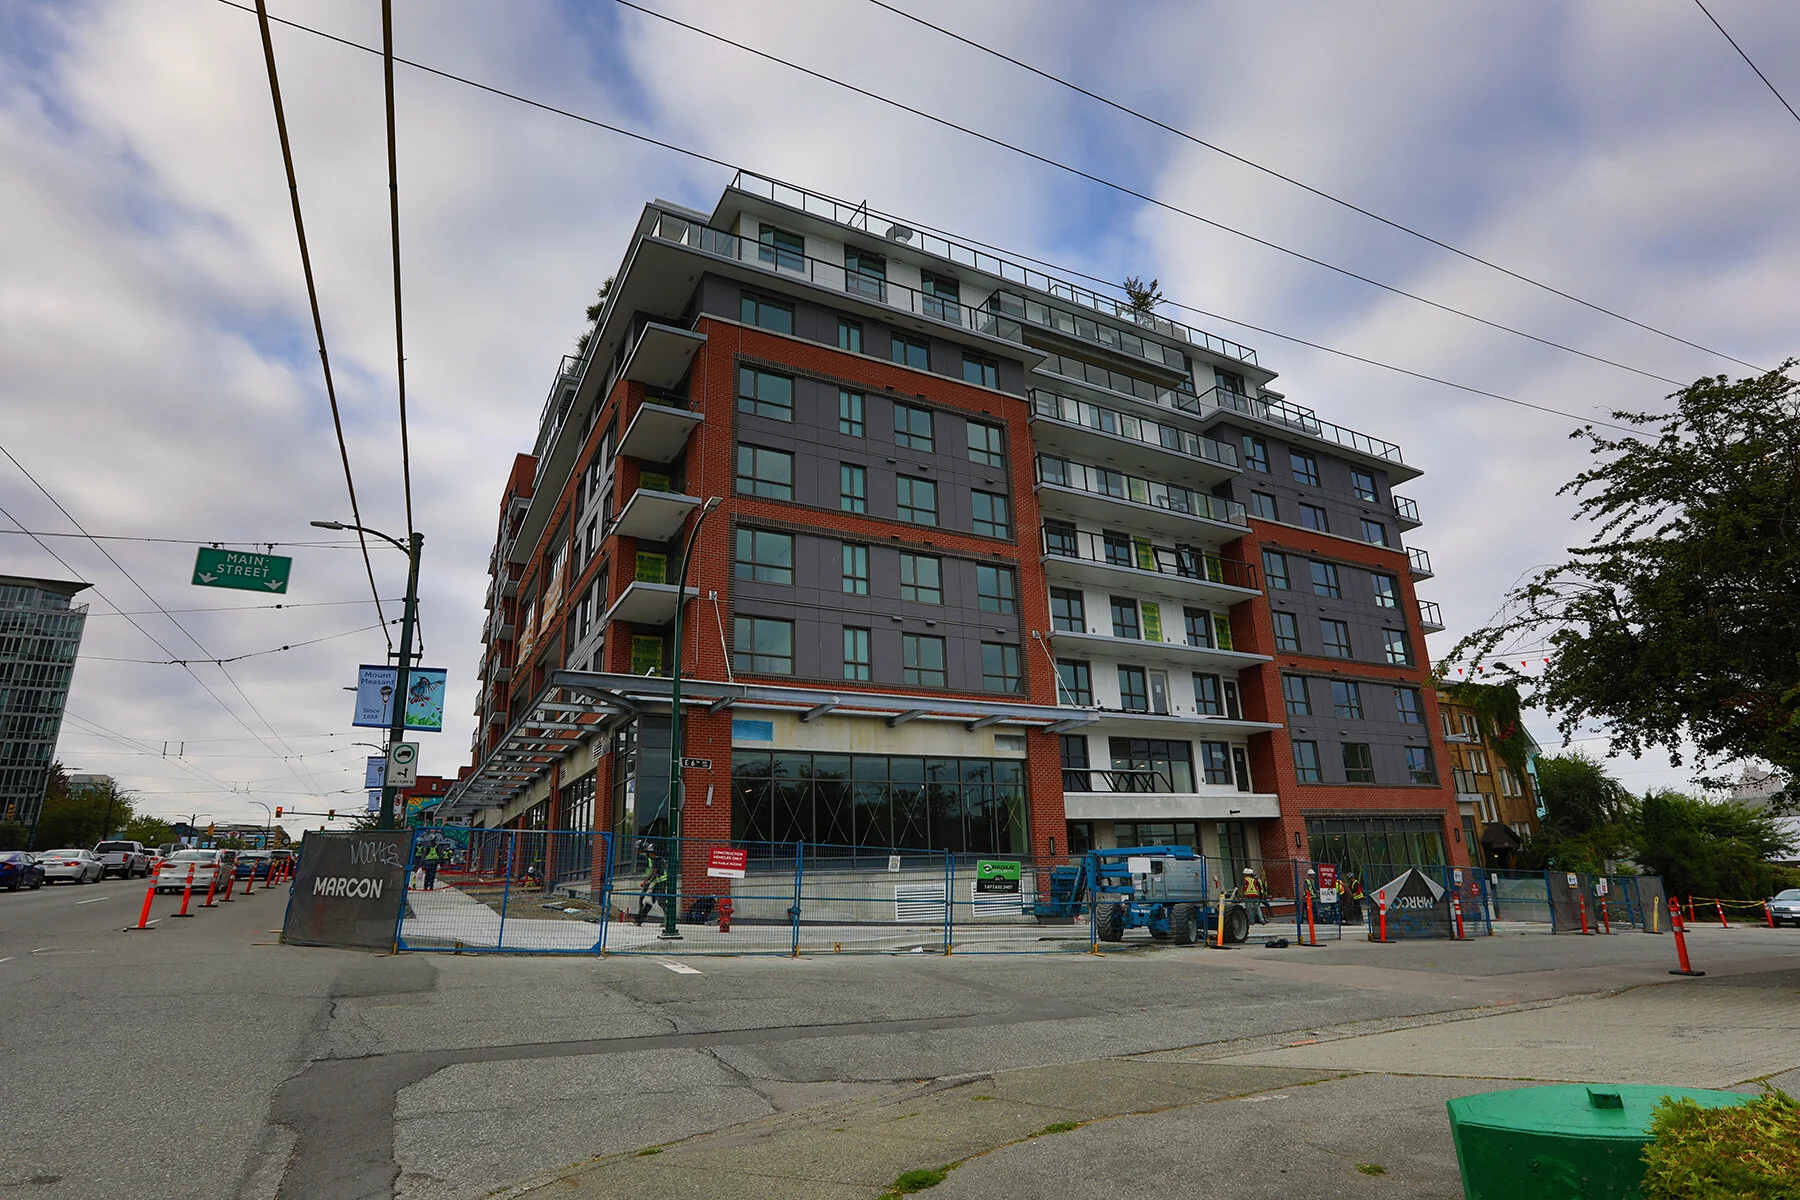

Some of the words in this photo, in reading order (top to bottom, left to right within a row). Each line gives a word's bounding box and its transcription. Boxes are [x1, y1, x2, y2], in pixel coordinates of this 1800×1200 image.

[226, 553, 264, 566] MAIN
[216, 564, 270, 578] STREET
[364, 671, 391, 679] Mount
[360, 678, 395, 686] Pleasant
[313, 876, 384, 899] MARCON
